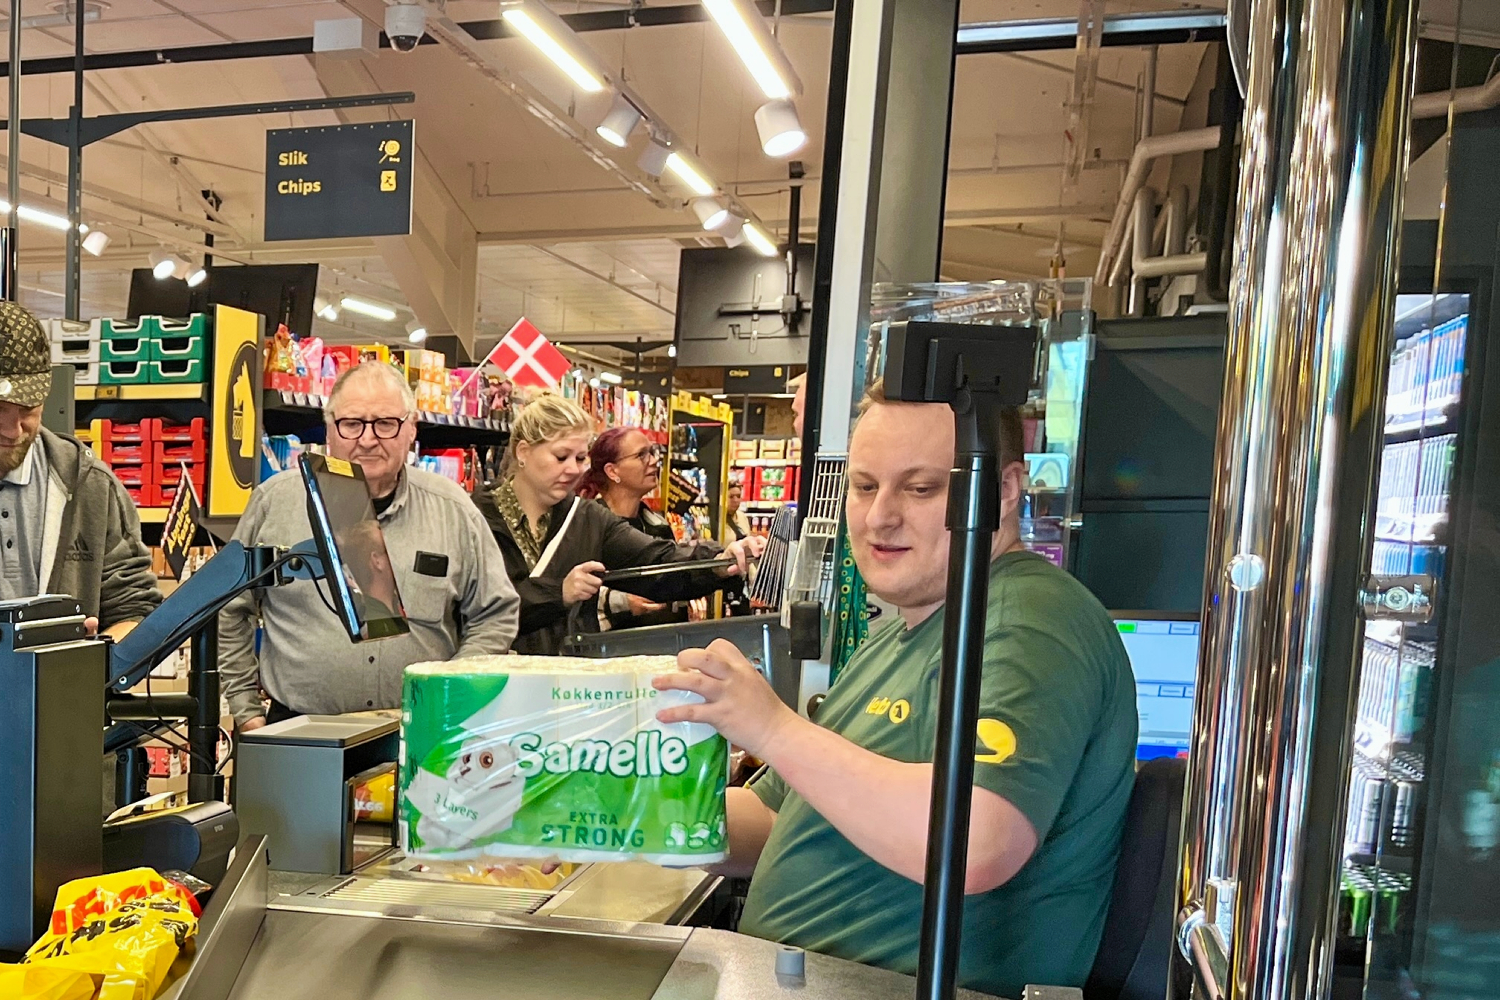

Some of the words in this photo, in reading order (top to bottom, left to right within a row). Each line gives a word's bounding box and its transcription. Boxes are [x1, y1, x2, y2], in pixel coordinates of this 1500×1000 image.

[278, 150, 309, 166] Slik
[277, 178, 322, 196] Chips
[551, 687, 658, 700] Køkkenrulle
[509, 730, 690, 778] Samelle
[434, 792, 441, 804] 3
[569, 811, 619, 826] EXTRA
[541, 823, 646, 848] STRONG
